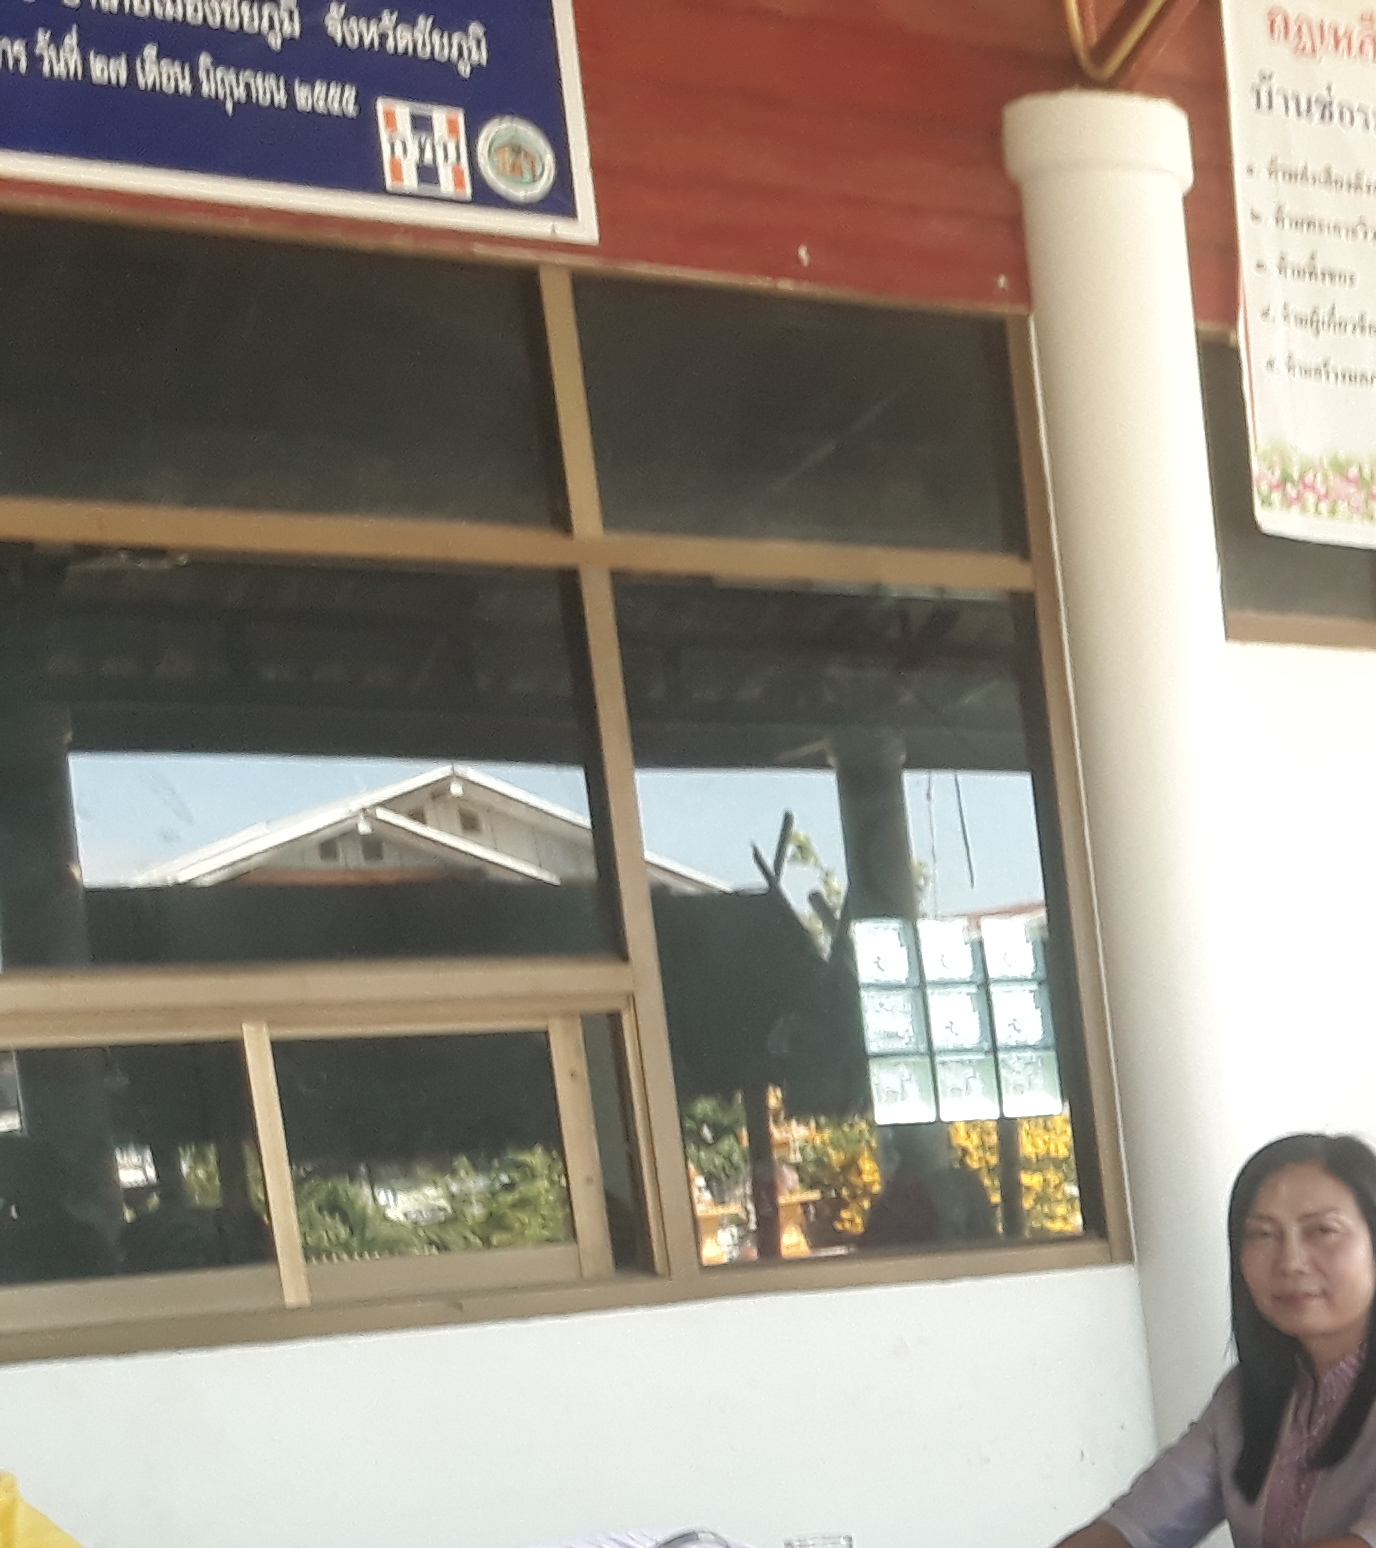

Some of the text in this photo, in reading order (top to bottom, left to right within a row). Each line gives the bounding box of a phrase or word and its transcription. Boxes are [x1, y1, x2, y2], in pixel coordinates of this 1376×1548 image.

[323, 1, 489, 79] จังหวัดชัยภูมิ
[134, 41, 192, 97] เดือน
[197, 49, 288, 117] มิถุนายน
